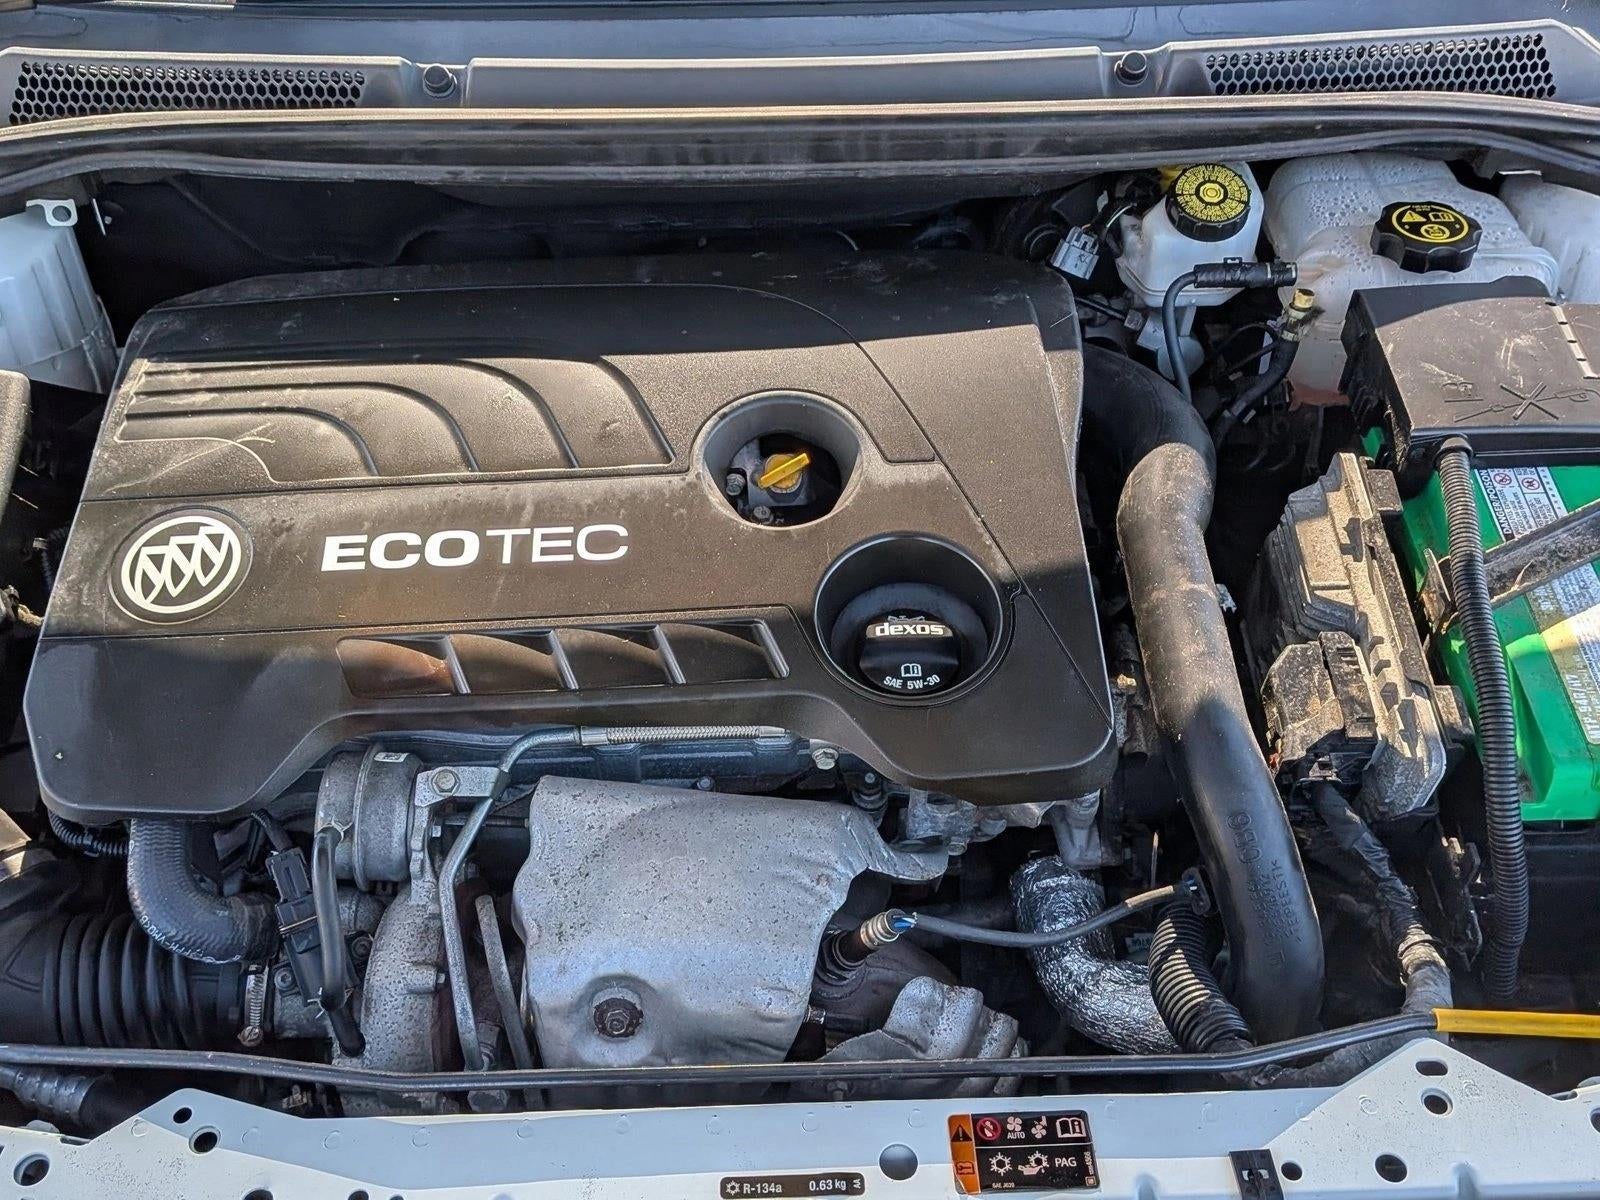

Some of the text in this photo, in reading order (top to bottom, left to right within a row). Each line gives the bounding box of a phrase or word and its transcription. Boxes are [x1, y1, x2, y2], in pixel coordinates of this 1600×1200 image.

[1479, 469, 1512, 535] DANGER/POISON
[320, 523, 629, 572] ECOTEC
[875, 622, 946, 637] dexos
[883, 674, 941, 690] SAE 5W-30
[1007, 1131, 1026, 1139] AUTO
[1055, 1156, 1077, 1168] PAG
[743, 1178, 847, 1194] R-134a 0.63 kg
